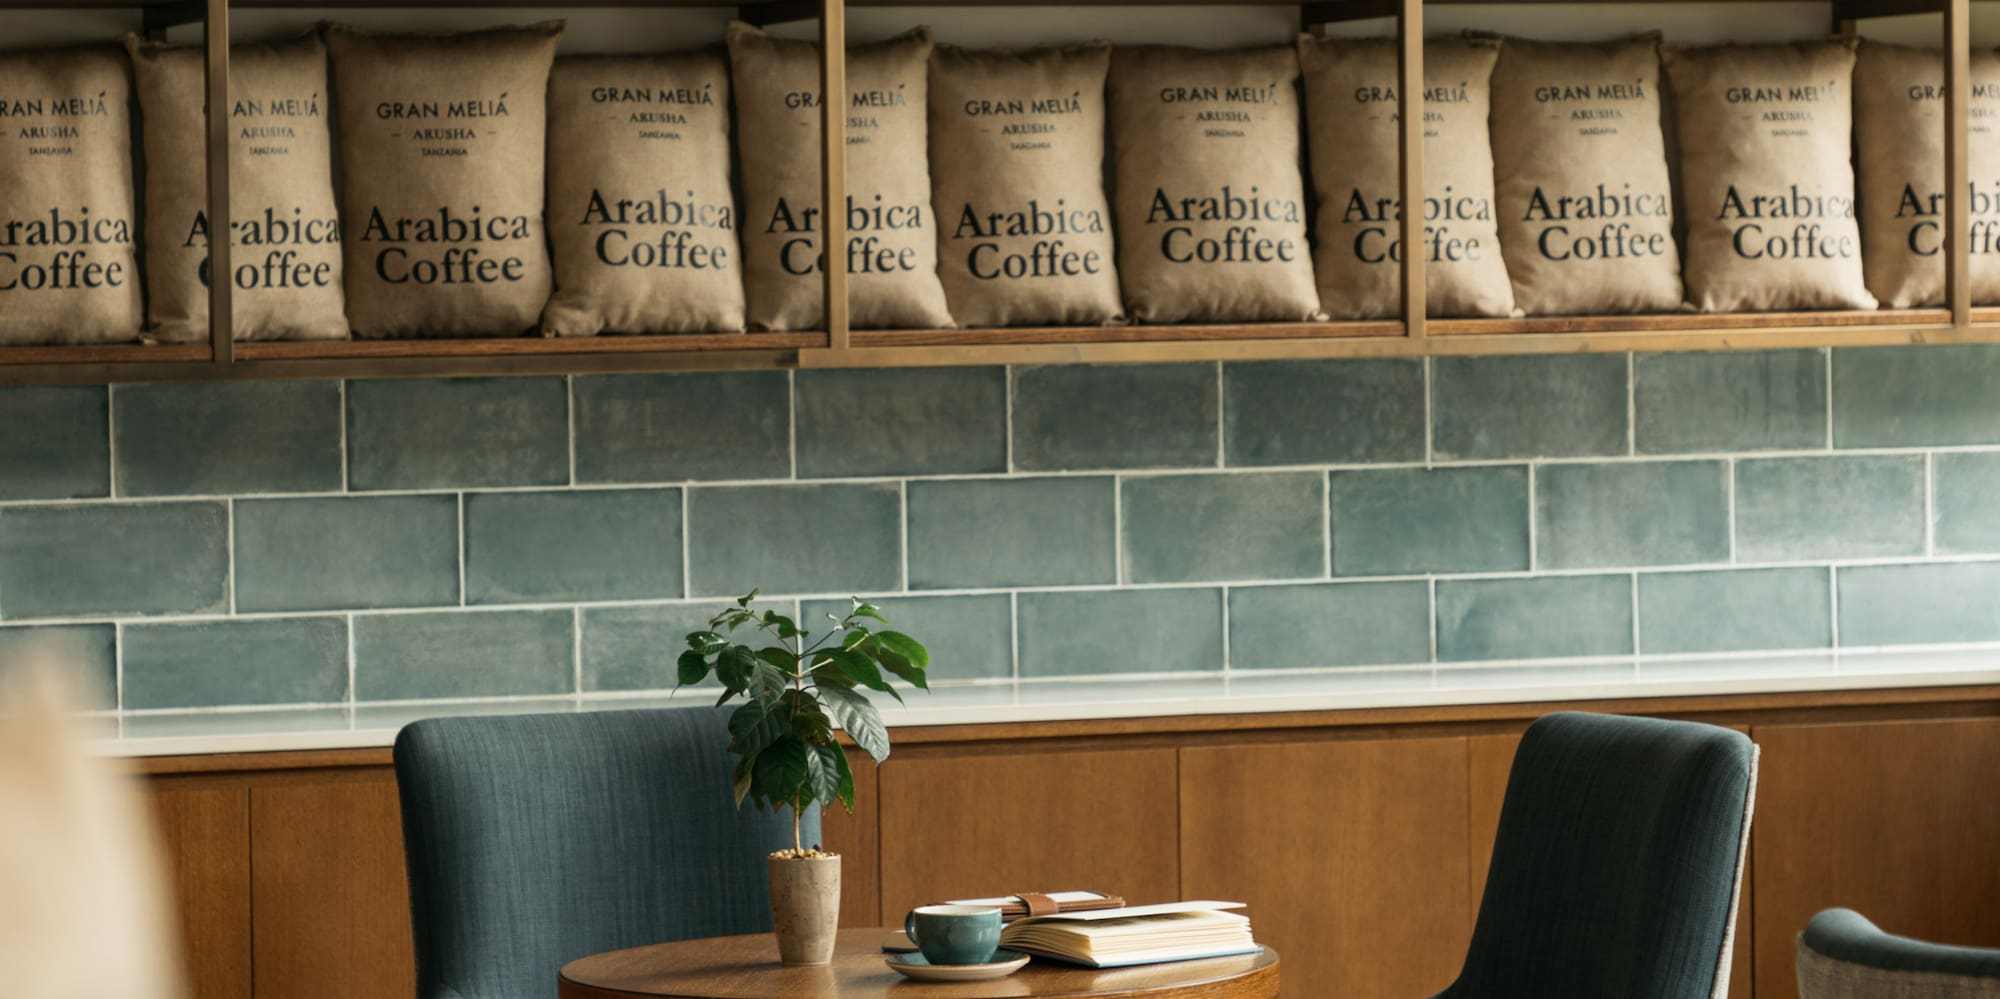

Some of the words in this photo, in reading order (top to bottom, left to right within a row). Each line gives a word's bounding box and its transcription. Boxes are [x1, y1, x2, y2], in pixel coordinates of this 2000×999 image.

[0, 98, 43, 116] RAN
[51, 90, 107, 116] MELIÁ
[271, 92, 319, 117] MELIÁ
[376, 101, 439, 120] GRAN
[447, 92, 508, 119] MELIÁ
[591, 87, 651, 104] GRAN
[659, 82, 714, 105] MELIÁ
[964, 100, 1024, 116] GRAN
[1031, 90, 1082, 114] MELIÁ
[1160, 87, 1218, 103] GRAN
[1226, 82, 1276, 104] MELIÁ
[1355, 86, 1398, 104] GRA
[1535, 84, 1591, 103] GRAN
[1597, 77, 1645, 99] MELIÁ
[1727, 87, 1782, 103] GRAN
[19, 127, 79, 139] ARUSHA
[413, 128, 476, 140] ARUSHA
[579, 188, 732, 230] Arabica
[765, 194, 922, 234] Arbica
[952, 199, 1104, 239] Arabica
[1145, 186, 1299, 224] Arabica
[1521, 182, 1668, 221] Arabica
[1715, 184, 1853, 221] Arabica
[0, 206, 129, 246] rabica
[182, 207, 339, 247] Aabica
[360, 206, 530, 242] Arabica
[1538, 223, 1664, 261] Coffee
[1733, 223, 1851, 260] Coffee
[596, 229, 727, 269] Coffee
[966, 240, 1101, 280] Coffee
[1161, 226, 1294, 263] Coffee
[198, 250, 331, 290] offee
[375, 248, 523, 285] Coffee
